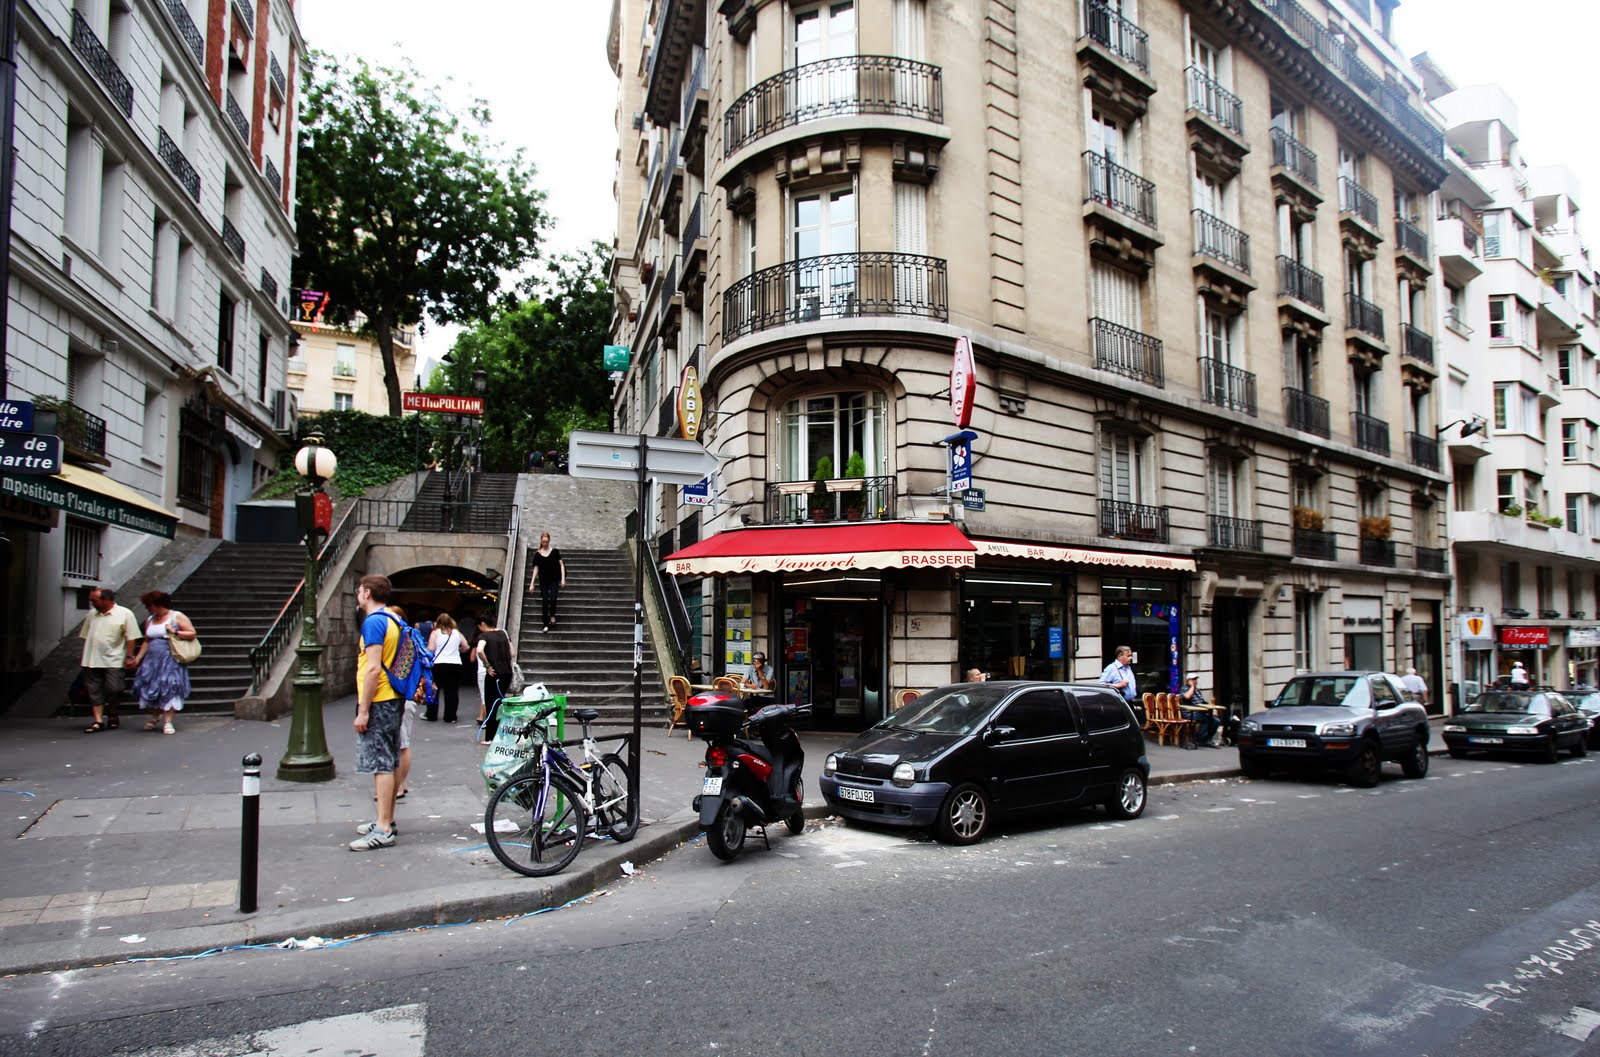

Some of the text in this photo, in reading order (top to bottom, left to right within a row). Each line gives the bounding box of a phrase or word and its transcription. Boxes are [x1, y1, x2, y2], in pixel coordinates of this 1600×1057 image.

[686, 375, 696, 435] TABAC
[0, 416, 24, 429] tre
[24, 437, 48, 452] de
[2, 476, 168, 535] mpositions Florales et Transmissions
[676, 554, 974, 572] BAR Le Lamarck BRASSERIE
[987, 544, 1009, 553] AMSTEL
[1027, 548, 1045, 557] BAR
[1145, 557, 1173, 567] BRASSERIE
